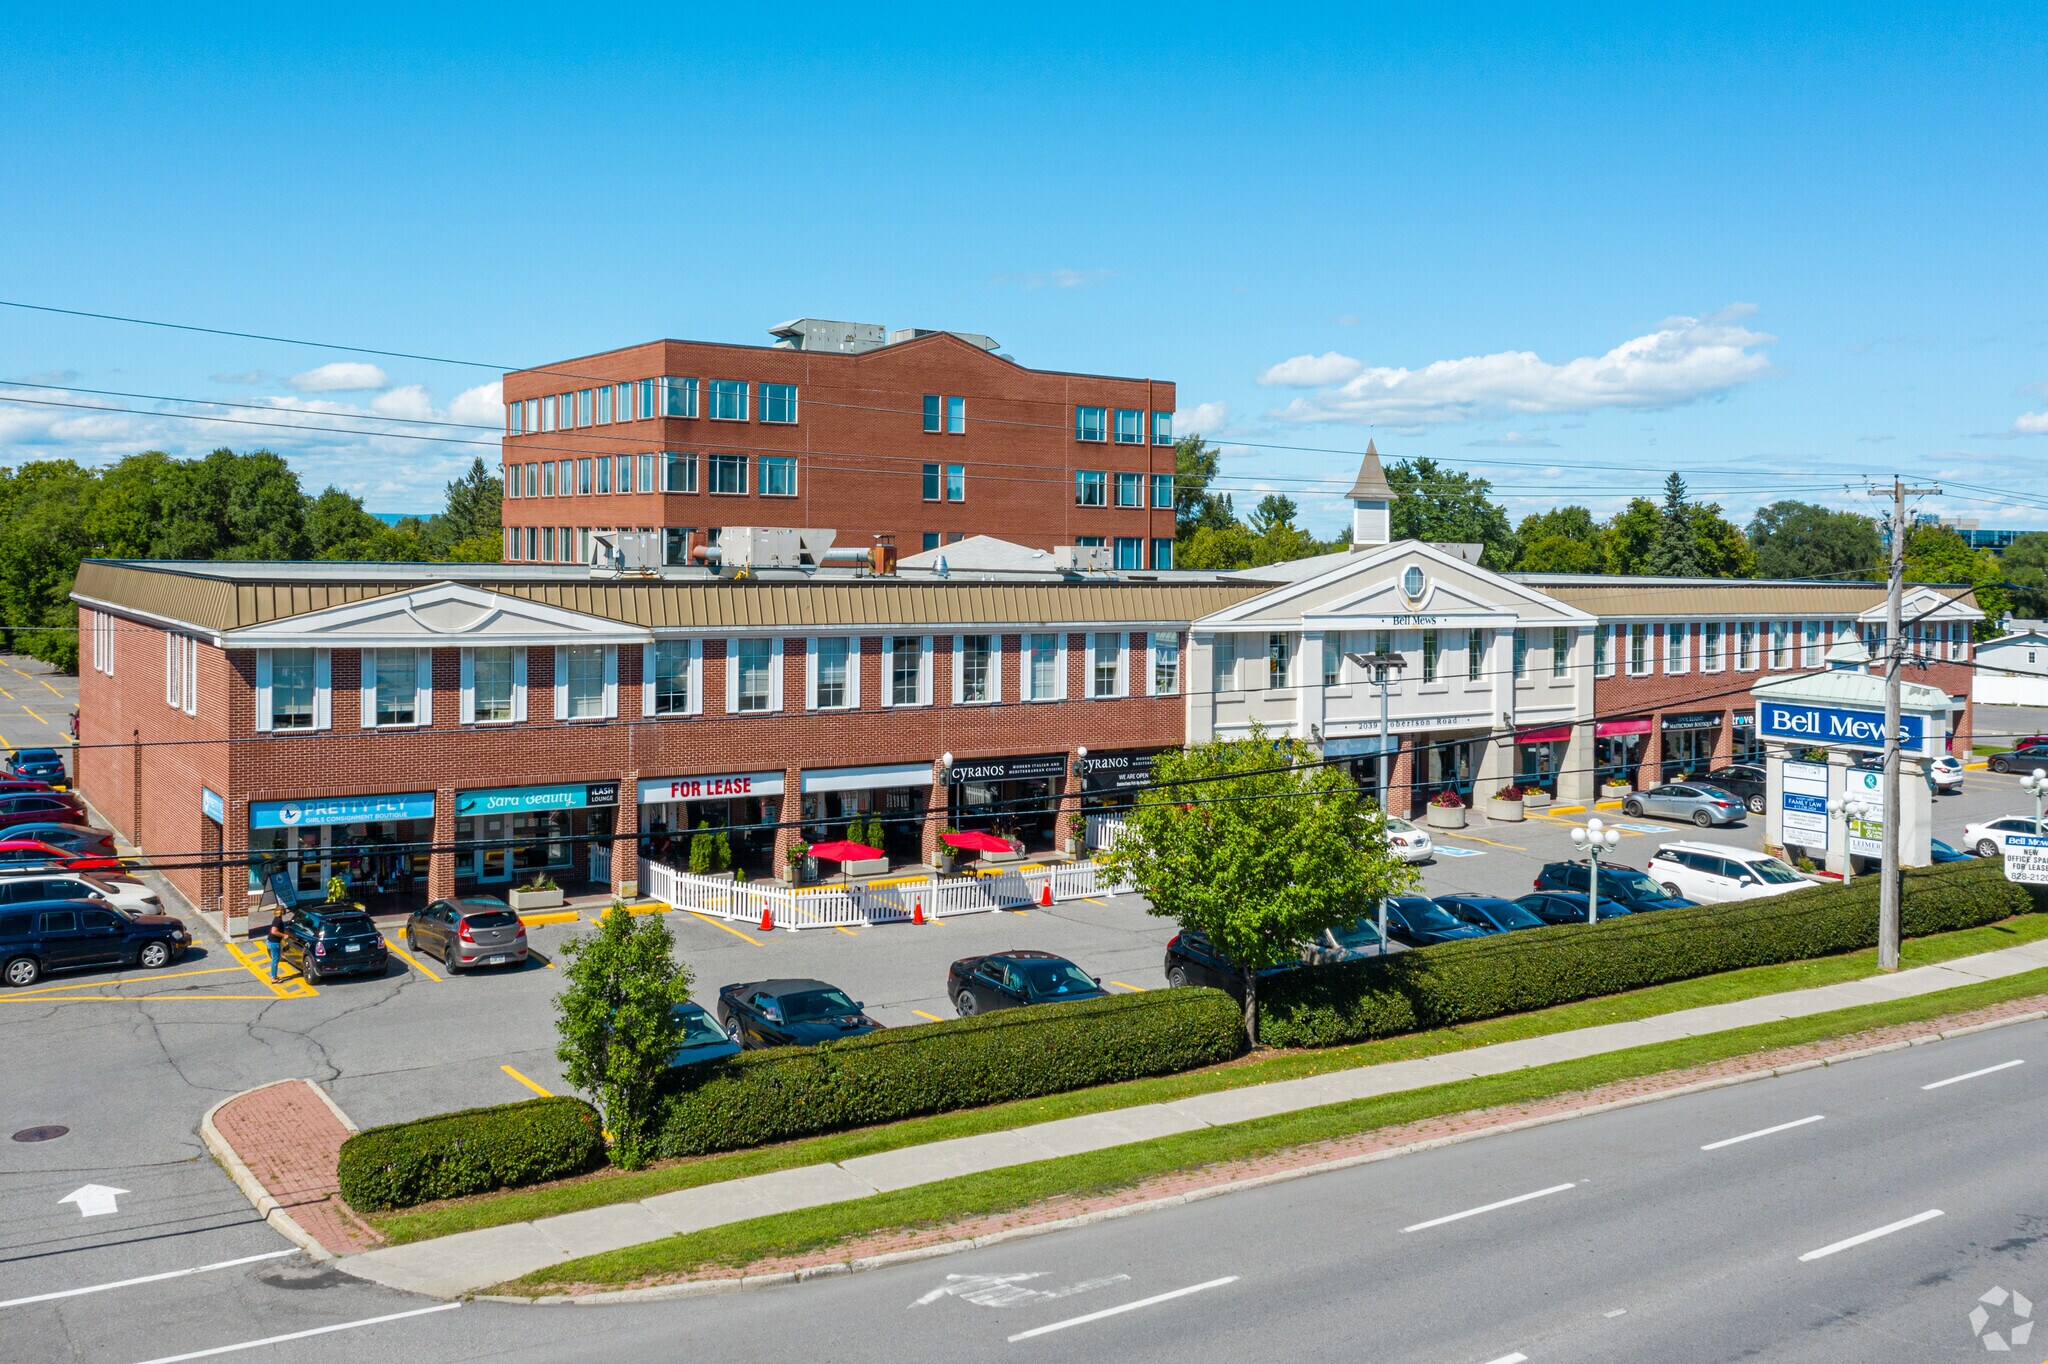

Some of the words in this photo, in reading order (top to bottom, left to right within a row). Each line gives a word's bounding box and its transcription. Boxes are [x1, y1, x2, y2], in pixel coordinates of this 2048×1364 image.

[1393, 615, 1410, 625] Bell
[1413, 615, 1437, 625] Mews
[1358, 722, 1378, 730] 2039
[1386, 719, 1431, 728] obertson
[1436, 717, 1458, 725] Road
[1772, 710, 1820, 733] Bell
[671, 781, 701, 798] FOR
[706, 777, 751, 796] LEASE
[305, 799, 370, 816] PRETTY
[376, 797, 408, 812] FLY
[487, 796, 519, 809] Sara
[523, 792, 576, 806] Beauty
[1788, 798, 1808, 806] FAMILY
[305, 816, 325, 824] GIRLS
[325, 814, 374, 823] CONSIGNMENT
[374, 812, 408, 820] BOUTIQUE
[2009, 837, 2026, 845] Bell
[2007, 855, 2030, 863] OFFICE
[2028, 864, 2048, 872] LEASE
